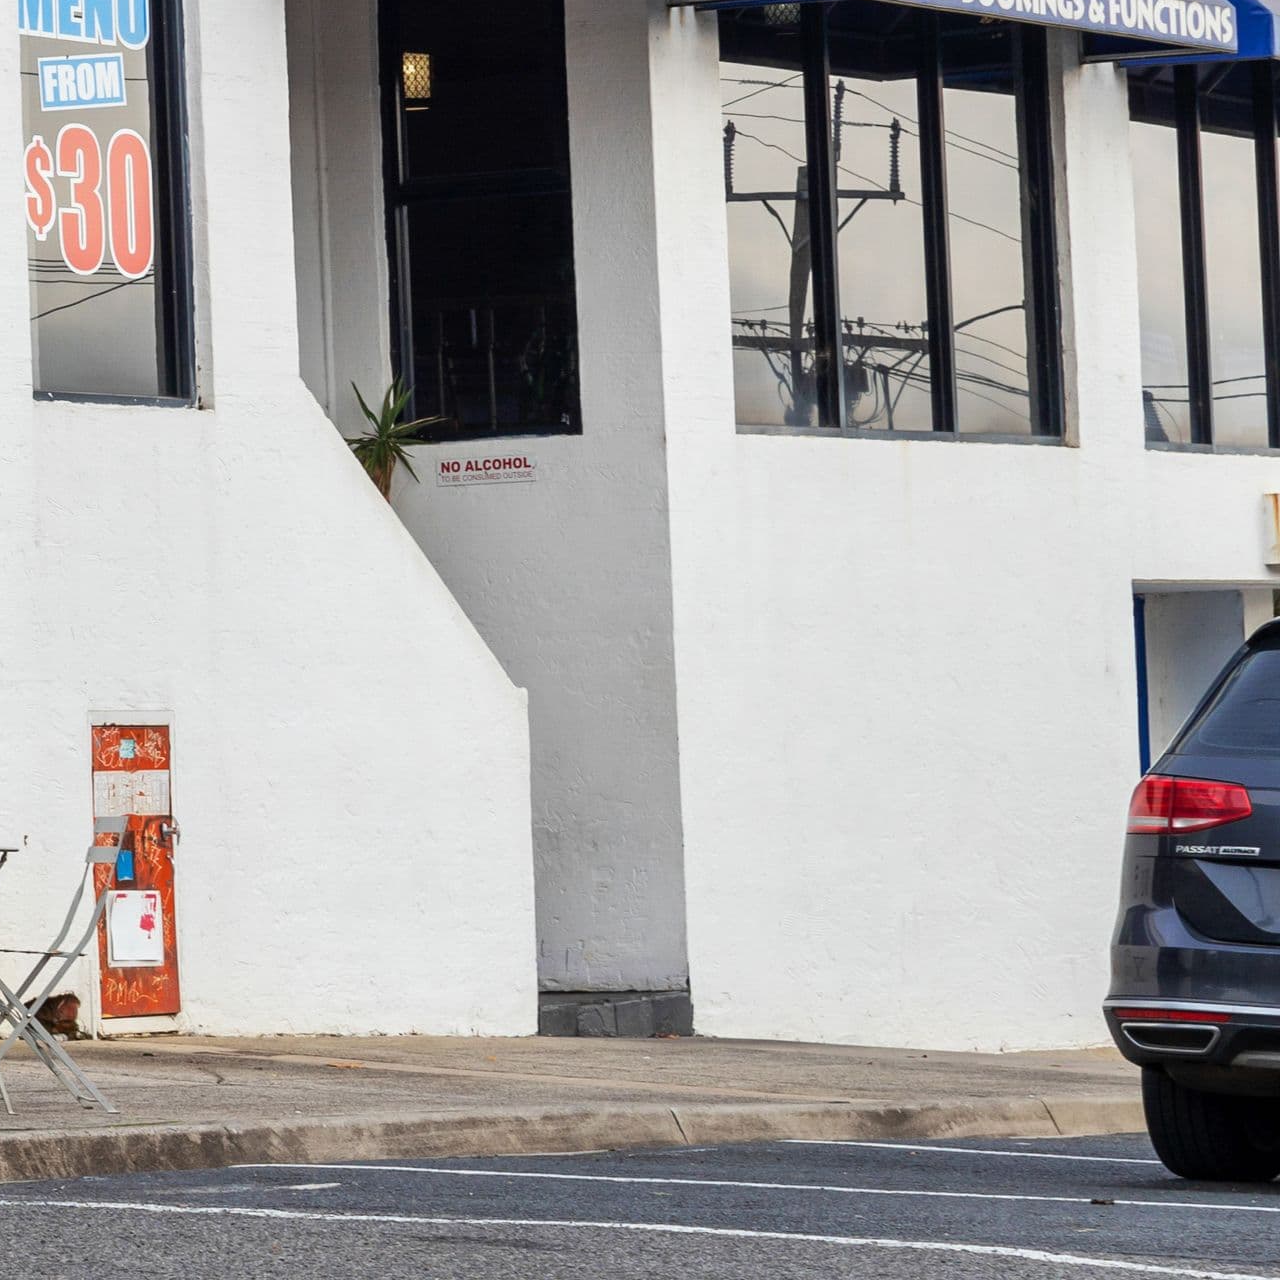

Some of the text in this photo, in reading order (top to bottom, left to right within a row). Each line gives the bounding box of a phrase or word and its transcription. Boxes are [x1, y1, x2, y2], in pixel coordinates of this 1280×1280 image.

[44, 62, 119, 104] FROM
[24, 123, 155, 279] $30
[441, 457, 531, 473] NO ALCOHOL
[1175, 845, 1219, 855] PASSAT
